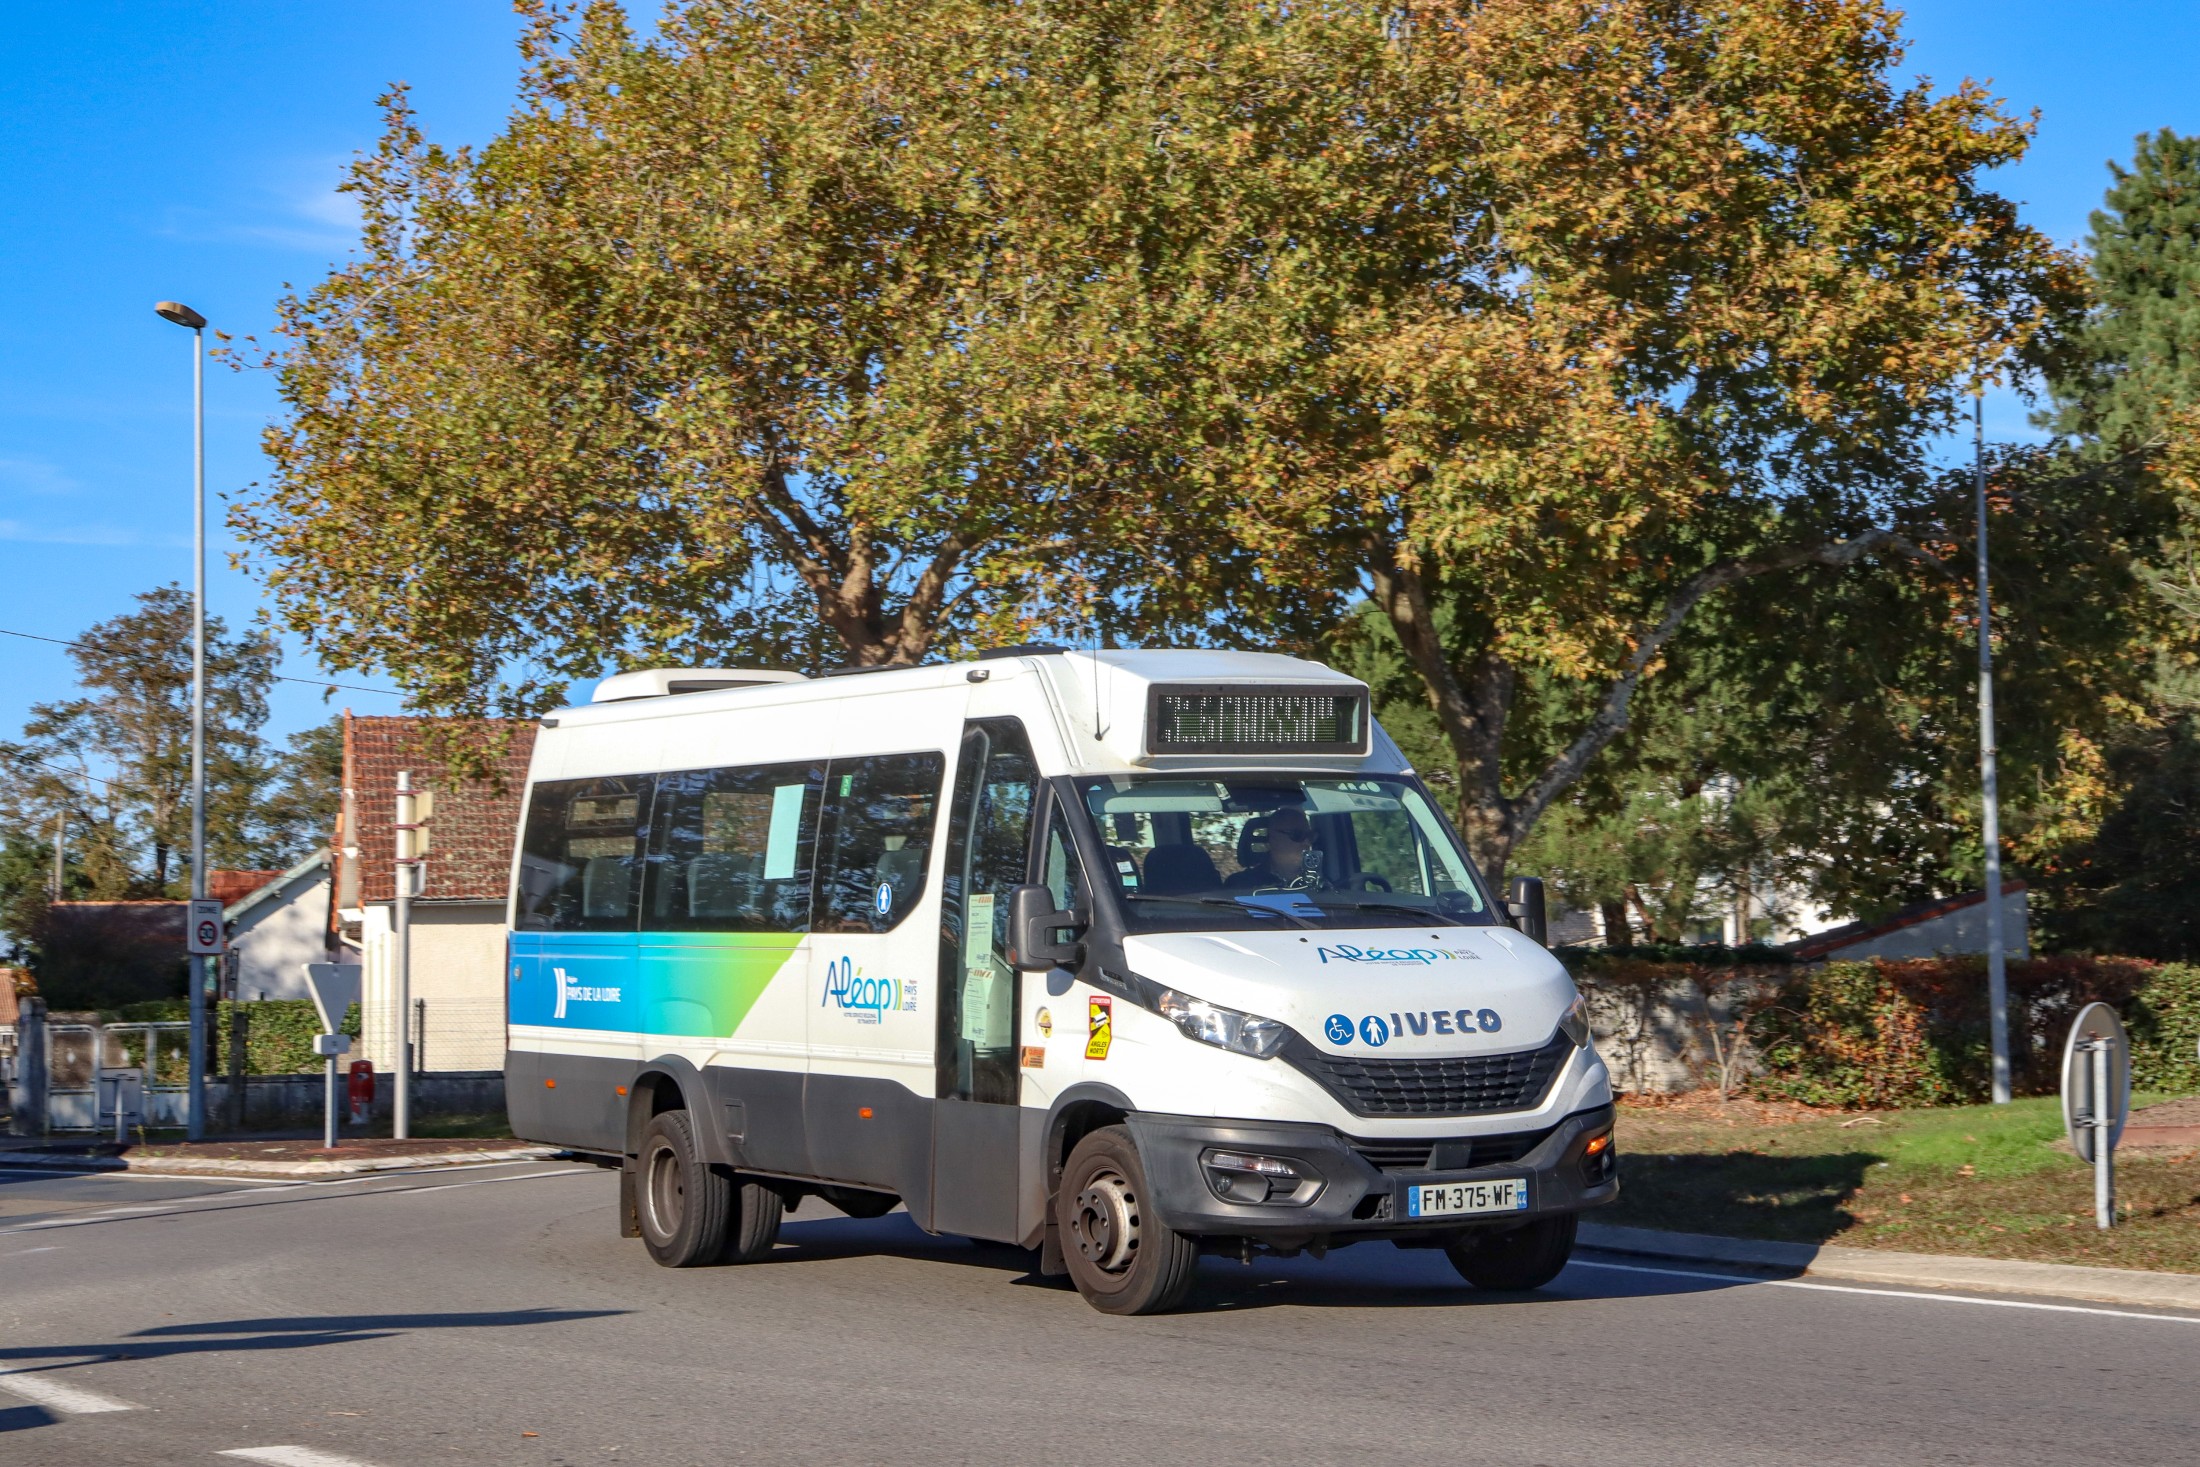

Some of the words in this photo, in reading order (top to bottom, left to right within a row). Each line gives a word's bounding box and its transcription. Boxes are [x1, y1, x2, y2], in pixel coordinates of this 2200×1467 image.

[200, 927, 213, 939] 30
[1390, 1008, 1502, 1038] IVECO
[1423, 1184, 1513, 1211] FM-375-WF
